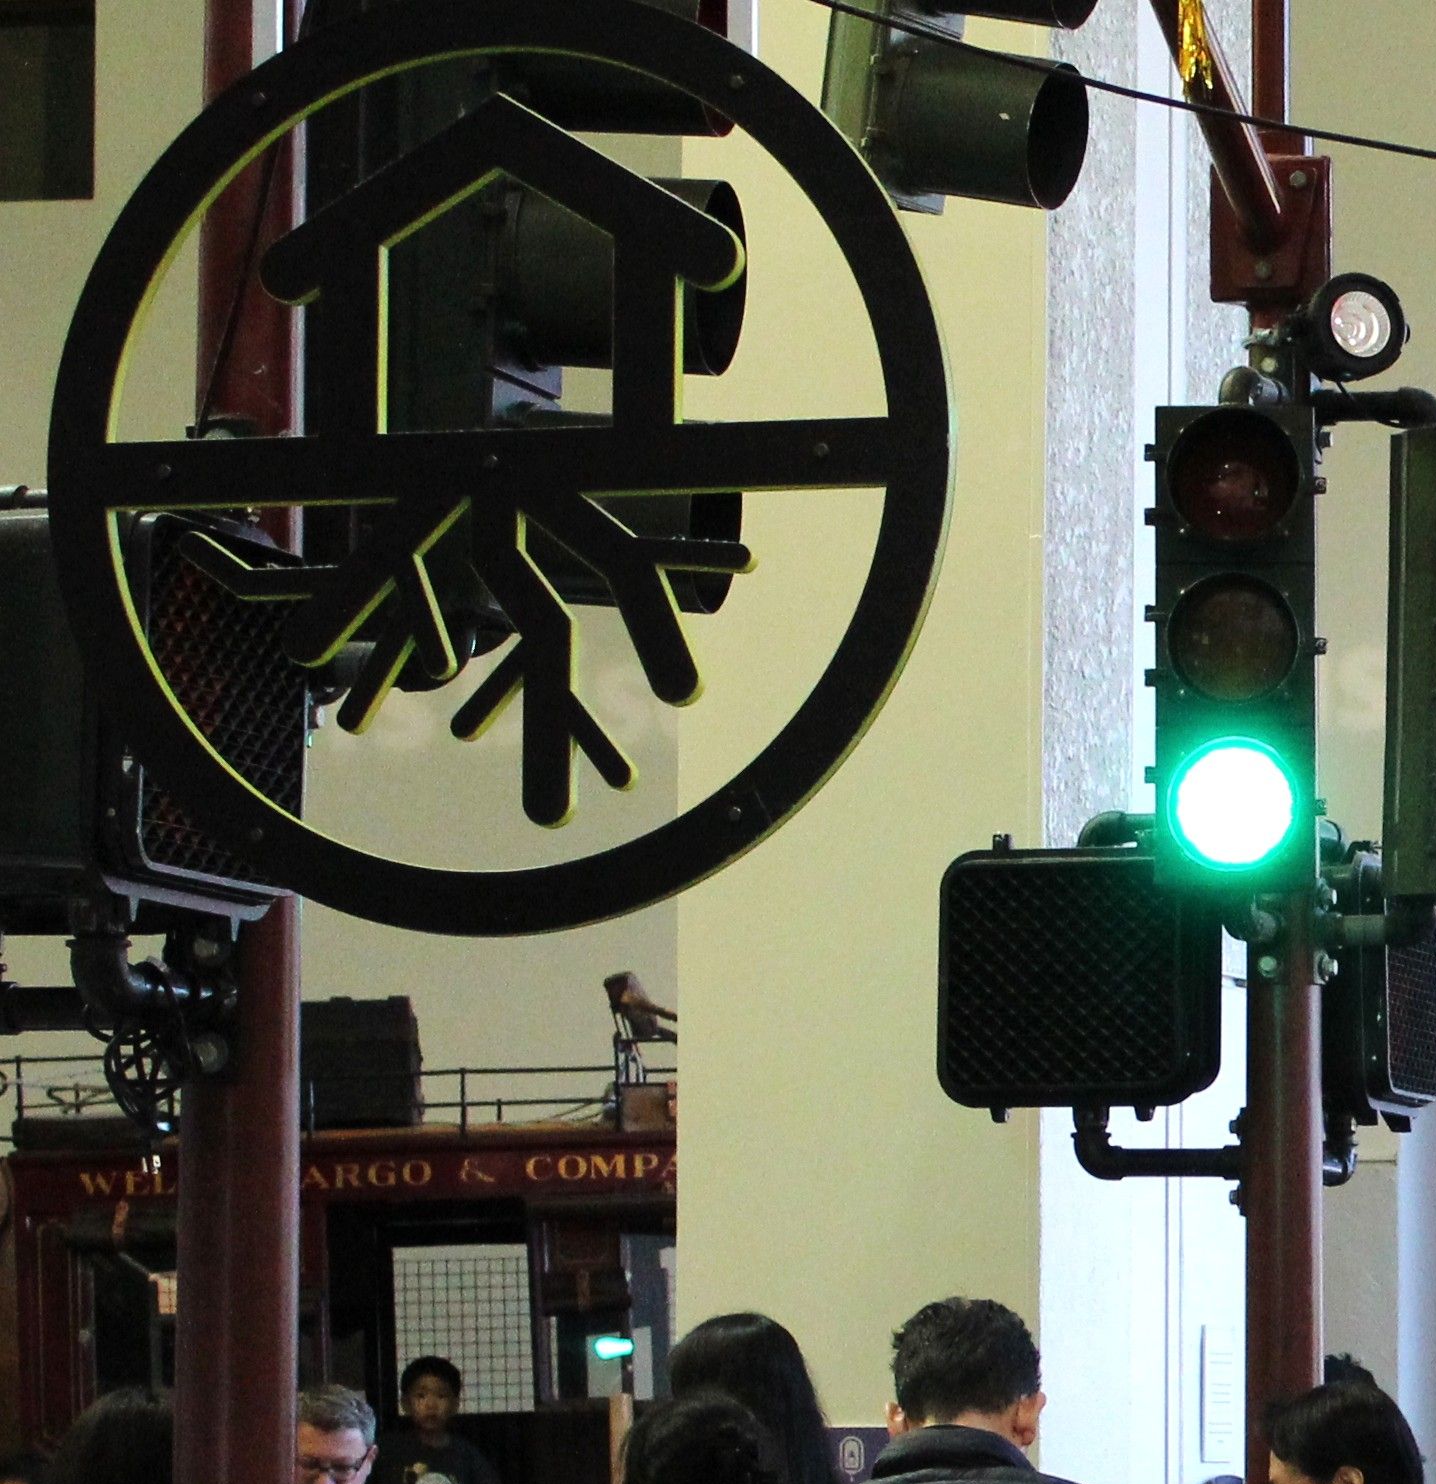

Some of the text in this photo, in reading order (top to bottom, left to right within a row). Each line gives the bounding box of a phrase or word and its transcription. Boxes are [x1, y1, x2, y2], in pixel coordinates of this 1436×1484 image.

[80, 1171, 178, 1195] WEL
[301, 1159, 432, 1189] ARGO
[460, 1158, 497, 1184] &
